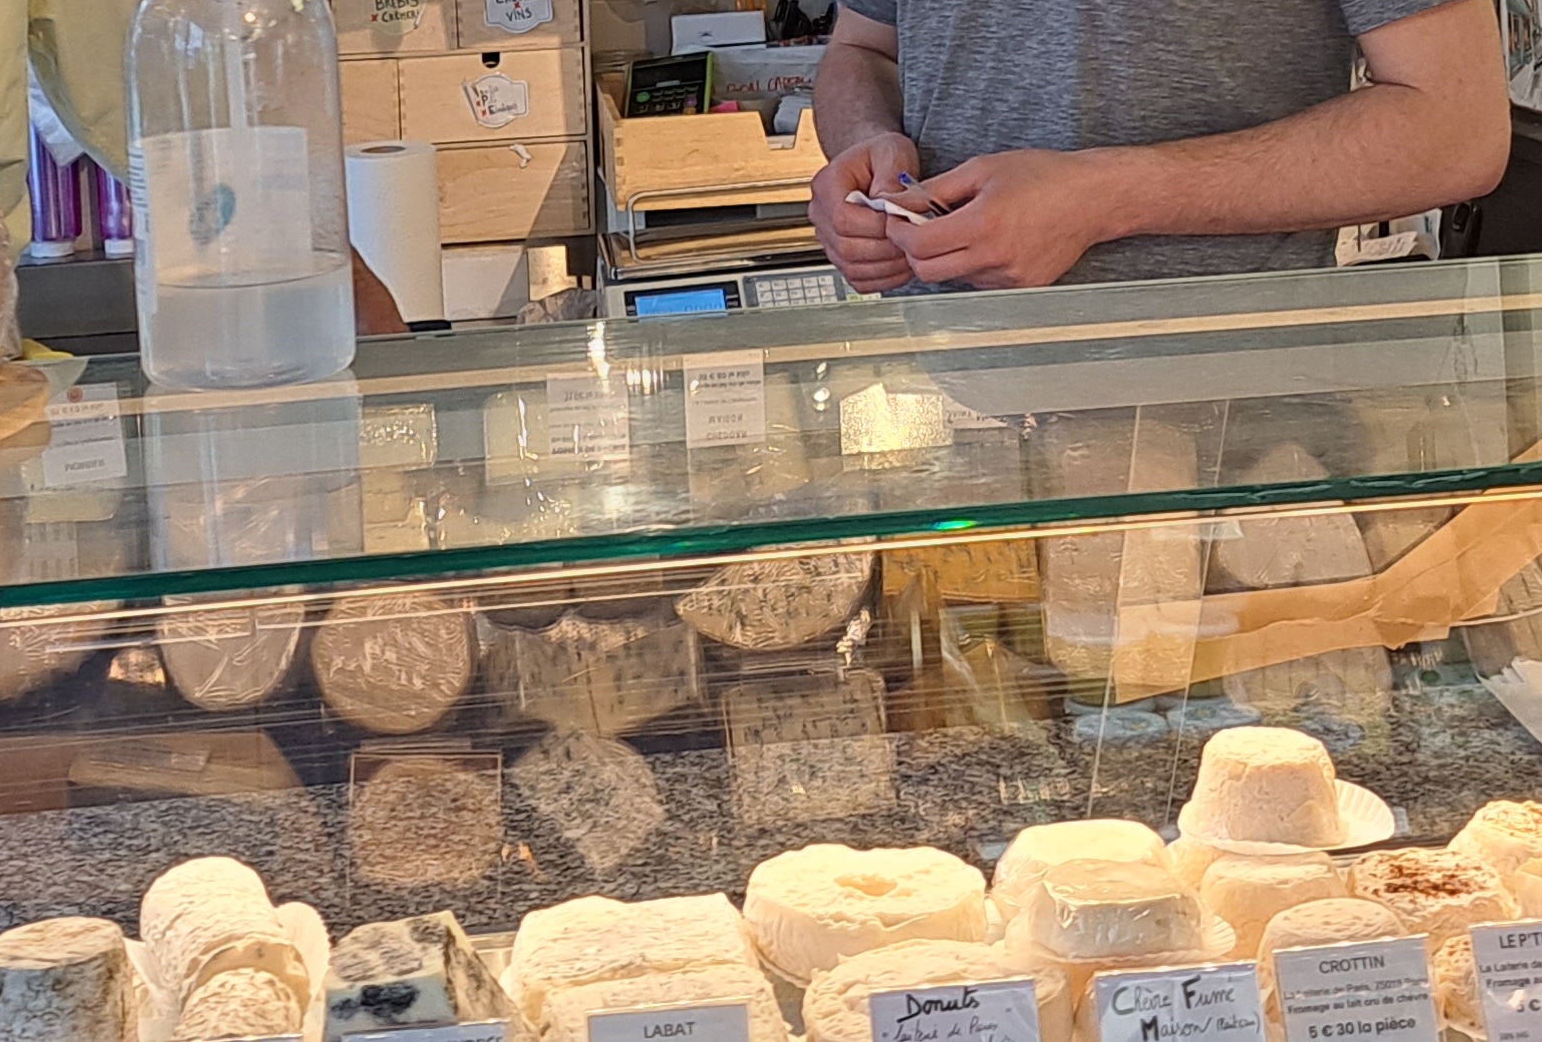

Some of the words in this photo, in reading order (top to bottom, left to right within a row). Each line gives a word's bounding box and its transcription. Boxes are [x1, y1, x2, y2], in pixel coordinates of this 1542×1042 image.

[505, 9, 533, 22] VINS
[1498, 933, 1518, 950] LE
[1318, 955, 1386, 975] CROTTIN
[896, 986, 980, 1024] Donuts
[643, 1020, 696, 1039] LABAT
[1140, 1014, 1213, 1042] Maison
[1308, 1025, 1318, 1040] 5
[1335, 1021, 1355, 1037] 30
[1357, 1020, 1373, 1034] la
[1374, 1016, 1417, 1036] pièce
